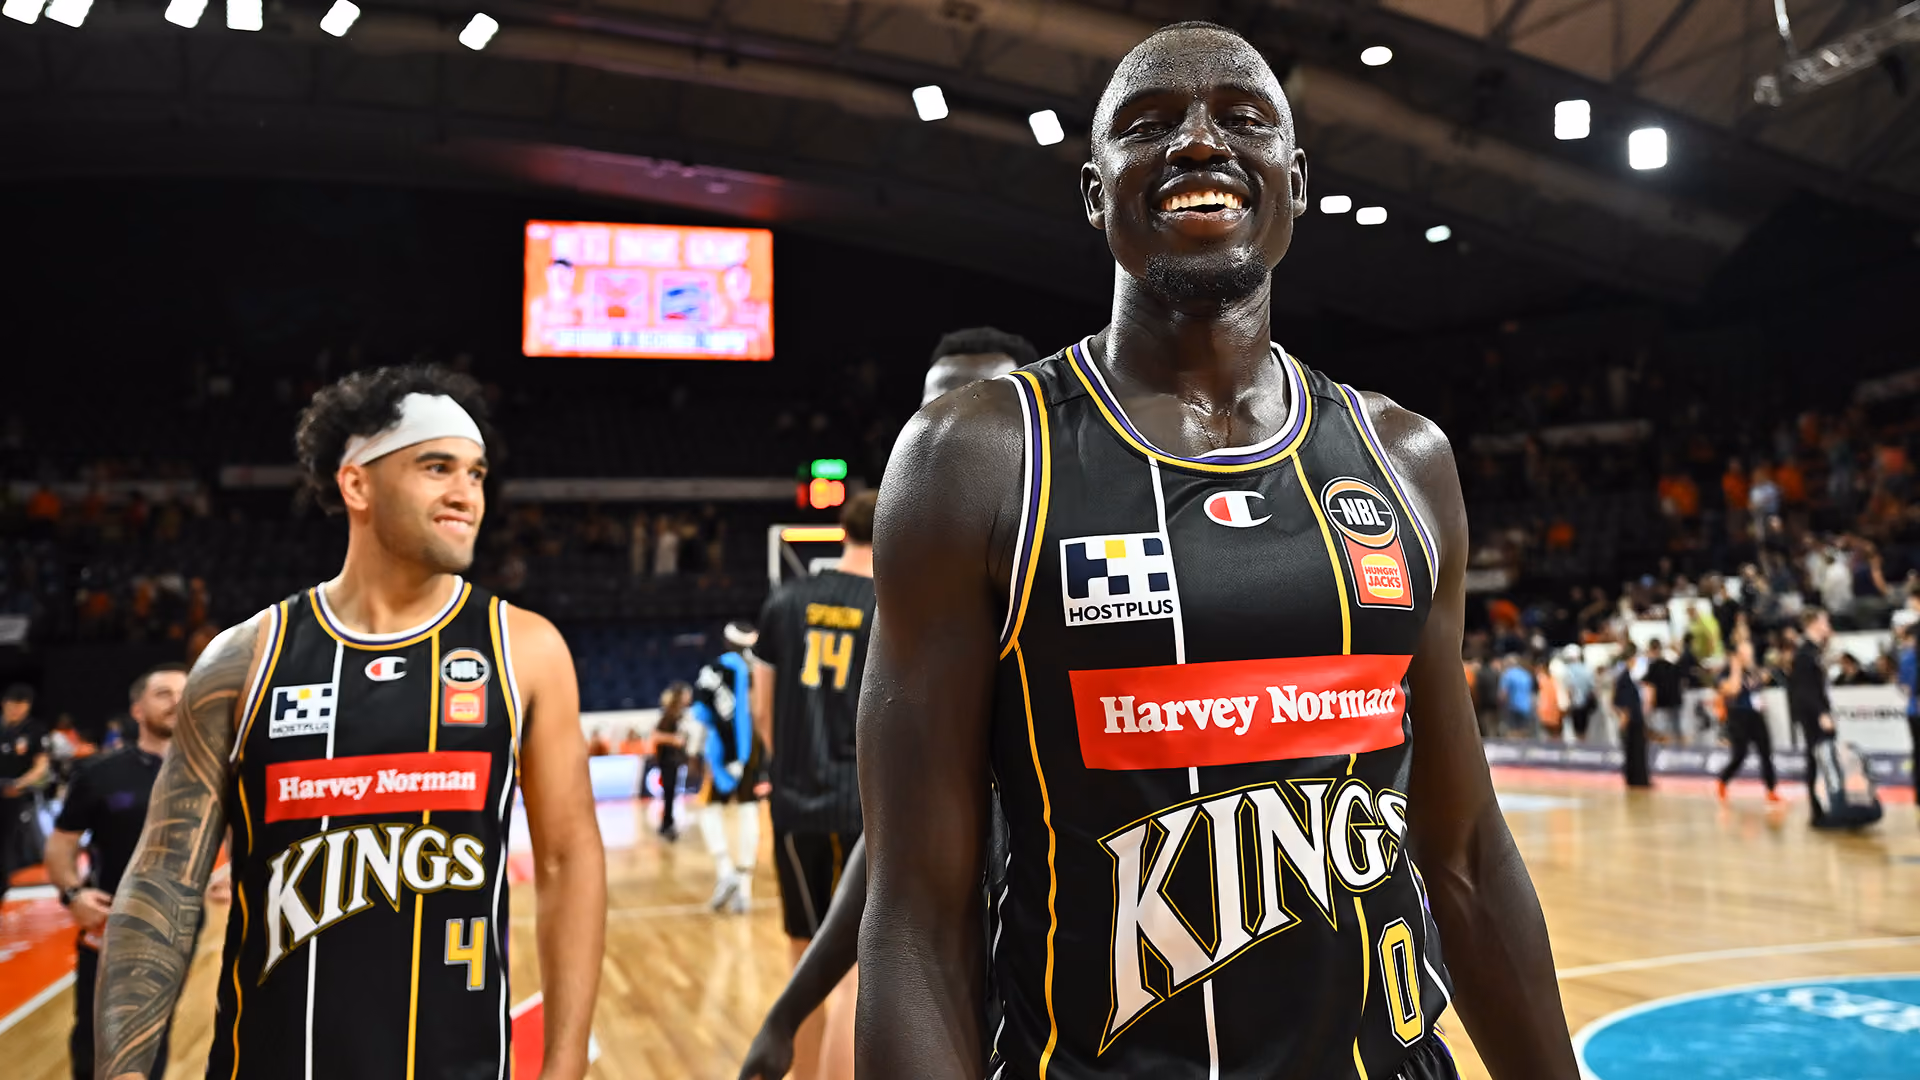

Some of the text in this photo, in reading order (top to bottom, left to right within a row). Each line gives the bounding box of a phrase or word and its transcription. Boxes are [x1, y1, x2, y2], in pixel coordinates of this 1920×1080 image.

[1337, 497, 1386, 527] NBL
[1364, 566, 1398, 576] HUNGRY
[1068, 599, 1174, 623] HOSTPLUS
[801, 628, 854, 690] 14
[1099, 684, 1396, 736] Harvey Norman
[278, 769, 477, 802] Harvey Norman
[260, 824, 485, 982] KINGS
[444, 917, 488, 991] 4
[1377, 917, 1425, 1048] 0
